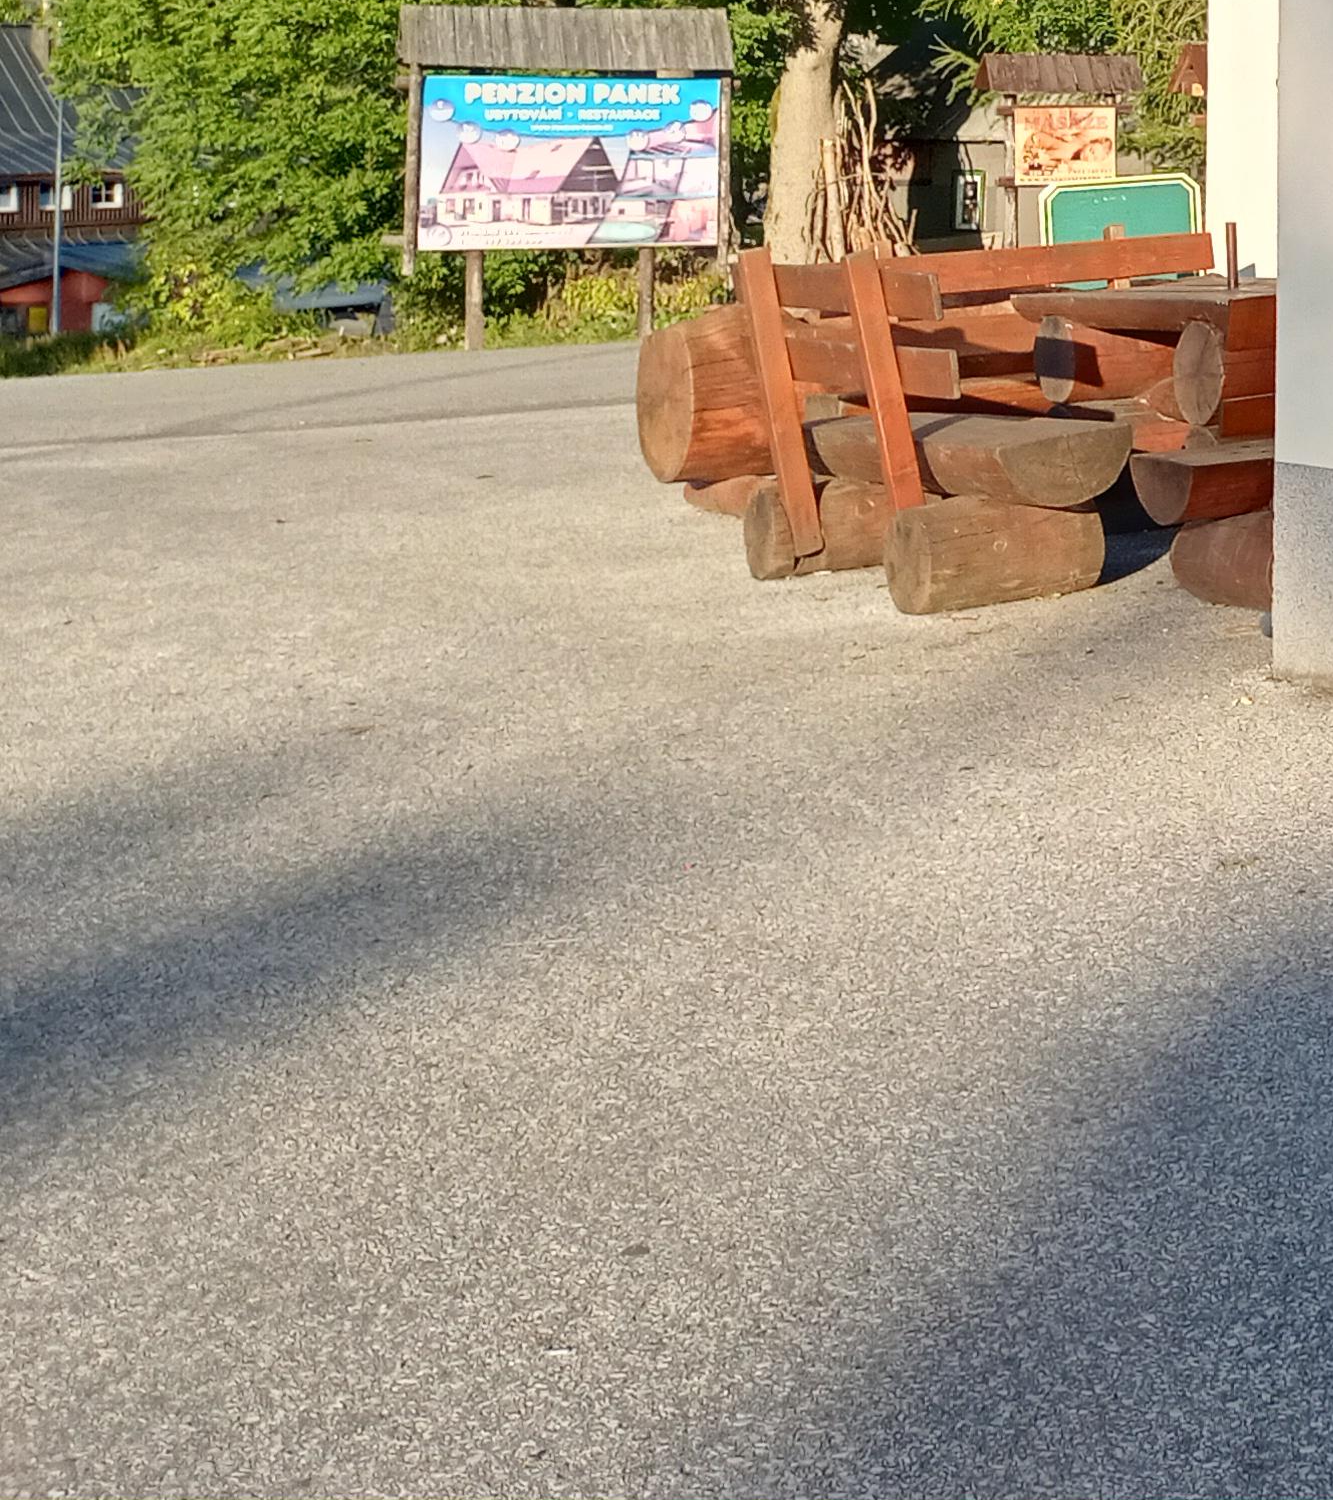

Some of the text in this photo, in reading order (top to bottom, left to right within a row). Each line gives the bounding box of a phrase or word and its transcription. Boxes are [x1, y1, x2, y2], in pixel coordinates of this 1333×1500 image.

[464, 83, 681, 105] PENZION PANEK
[484, 106, 661, 121] UBYTOVÁNÍ RESTAURACE
